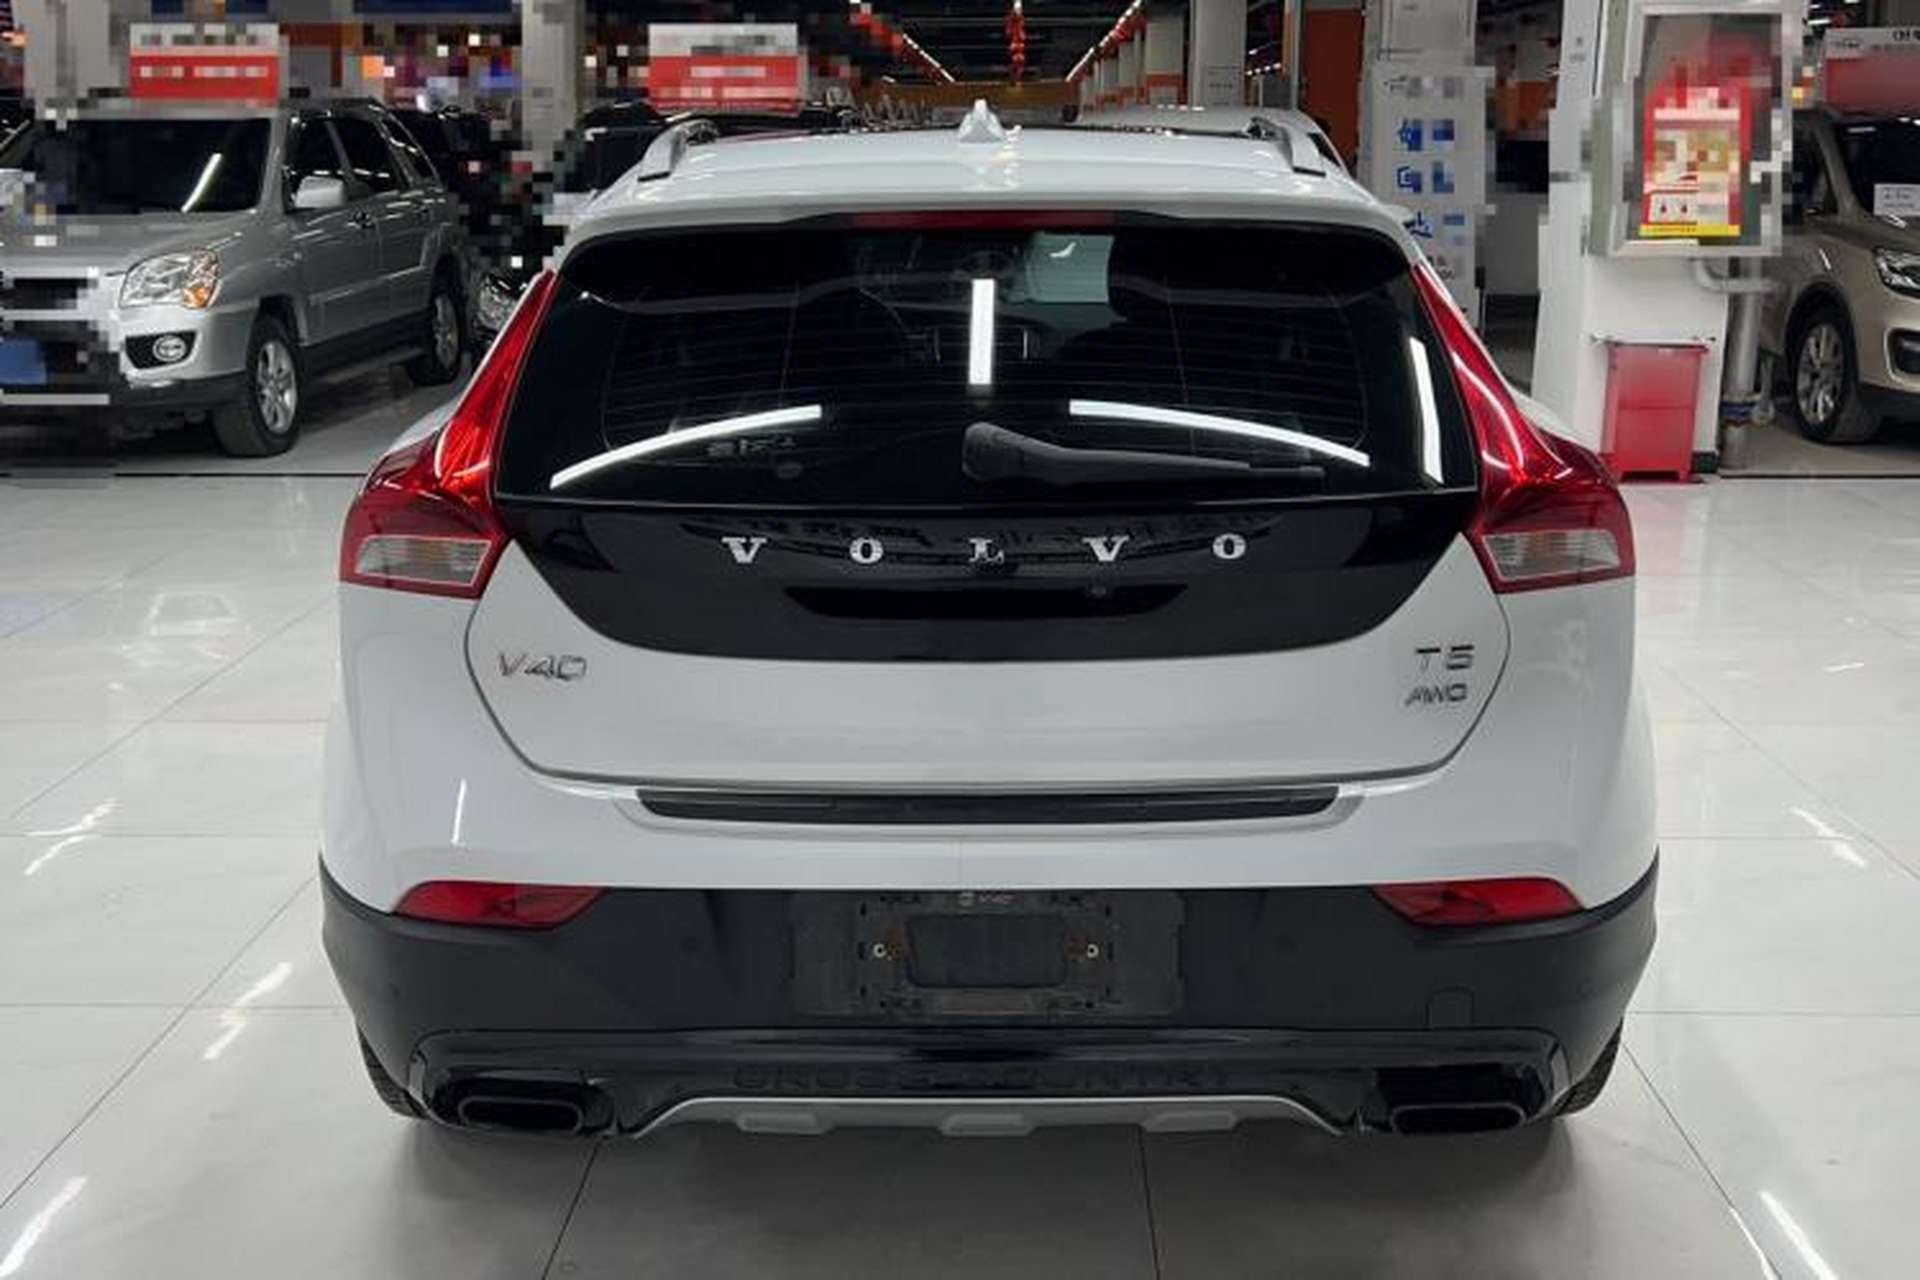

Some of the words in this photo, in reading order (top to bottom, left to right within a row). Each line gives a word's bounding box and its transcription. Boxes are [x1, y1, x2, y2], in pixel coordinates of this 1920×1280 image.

[721, 533, 1247, 565] VOLVO
[497, 653, 588, 681] V40
[1415, 644, 1475, 671] T5
